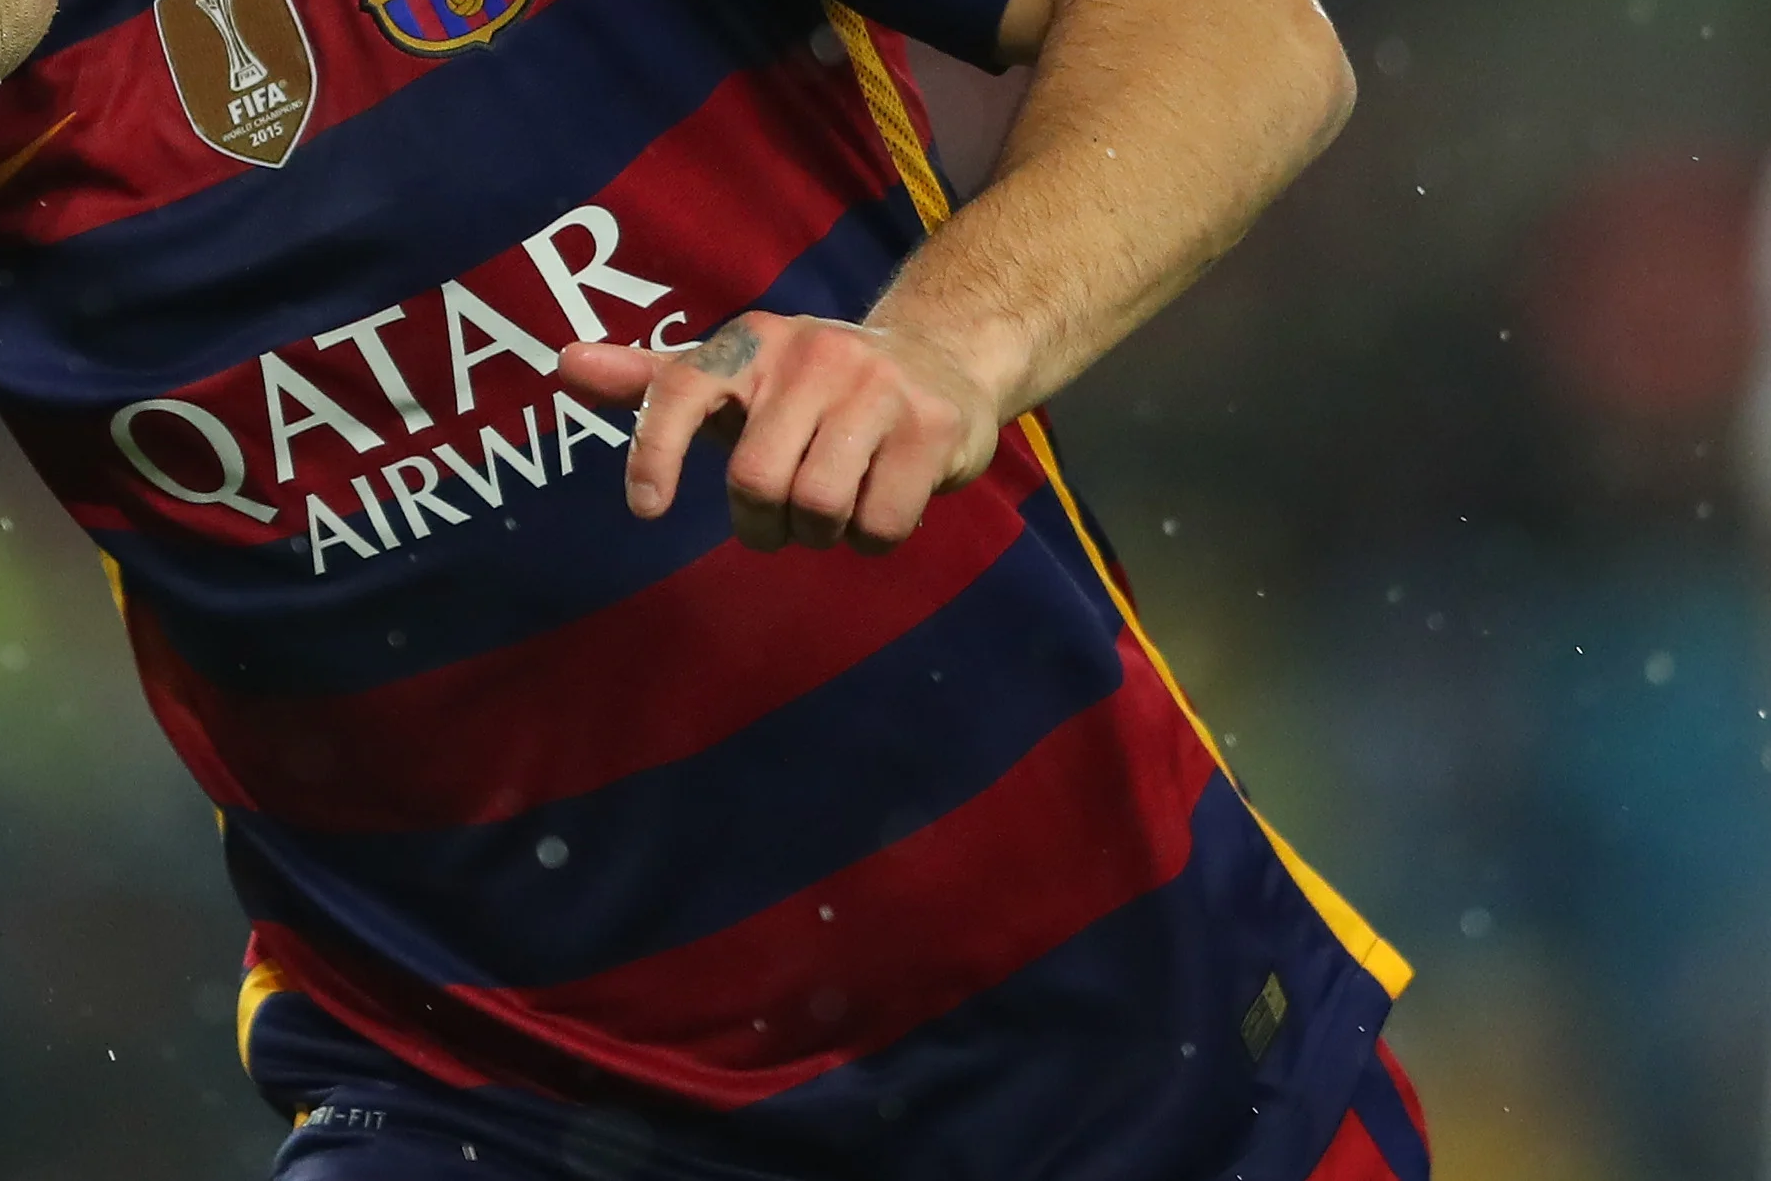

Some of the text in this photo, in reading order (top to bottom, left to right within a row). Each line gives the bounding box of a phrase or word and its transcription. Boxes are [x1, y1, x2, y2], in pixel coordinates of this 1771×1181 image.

[249, 121, 284, 148] 2015
[110, 205, 673, 525] QATAR
[305, 310, 704, 576] AIRWAS
